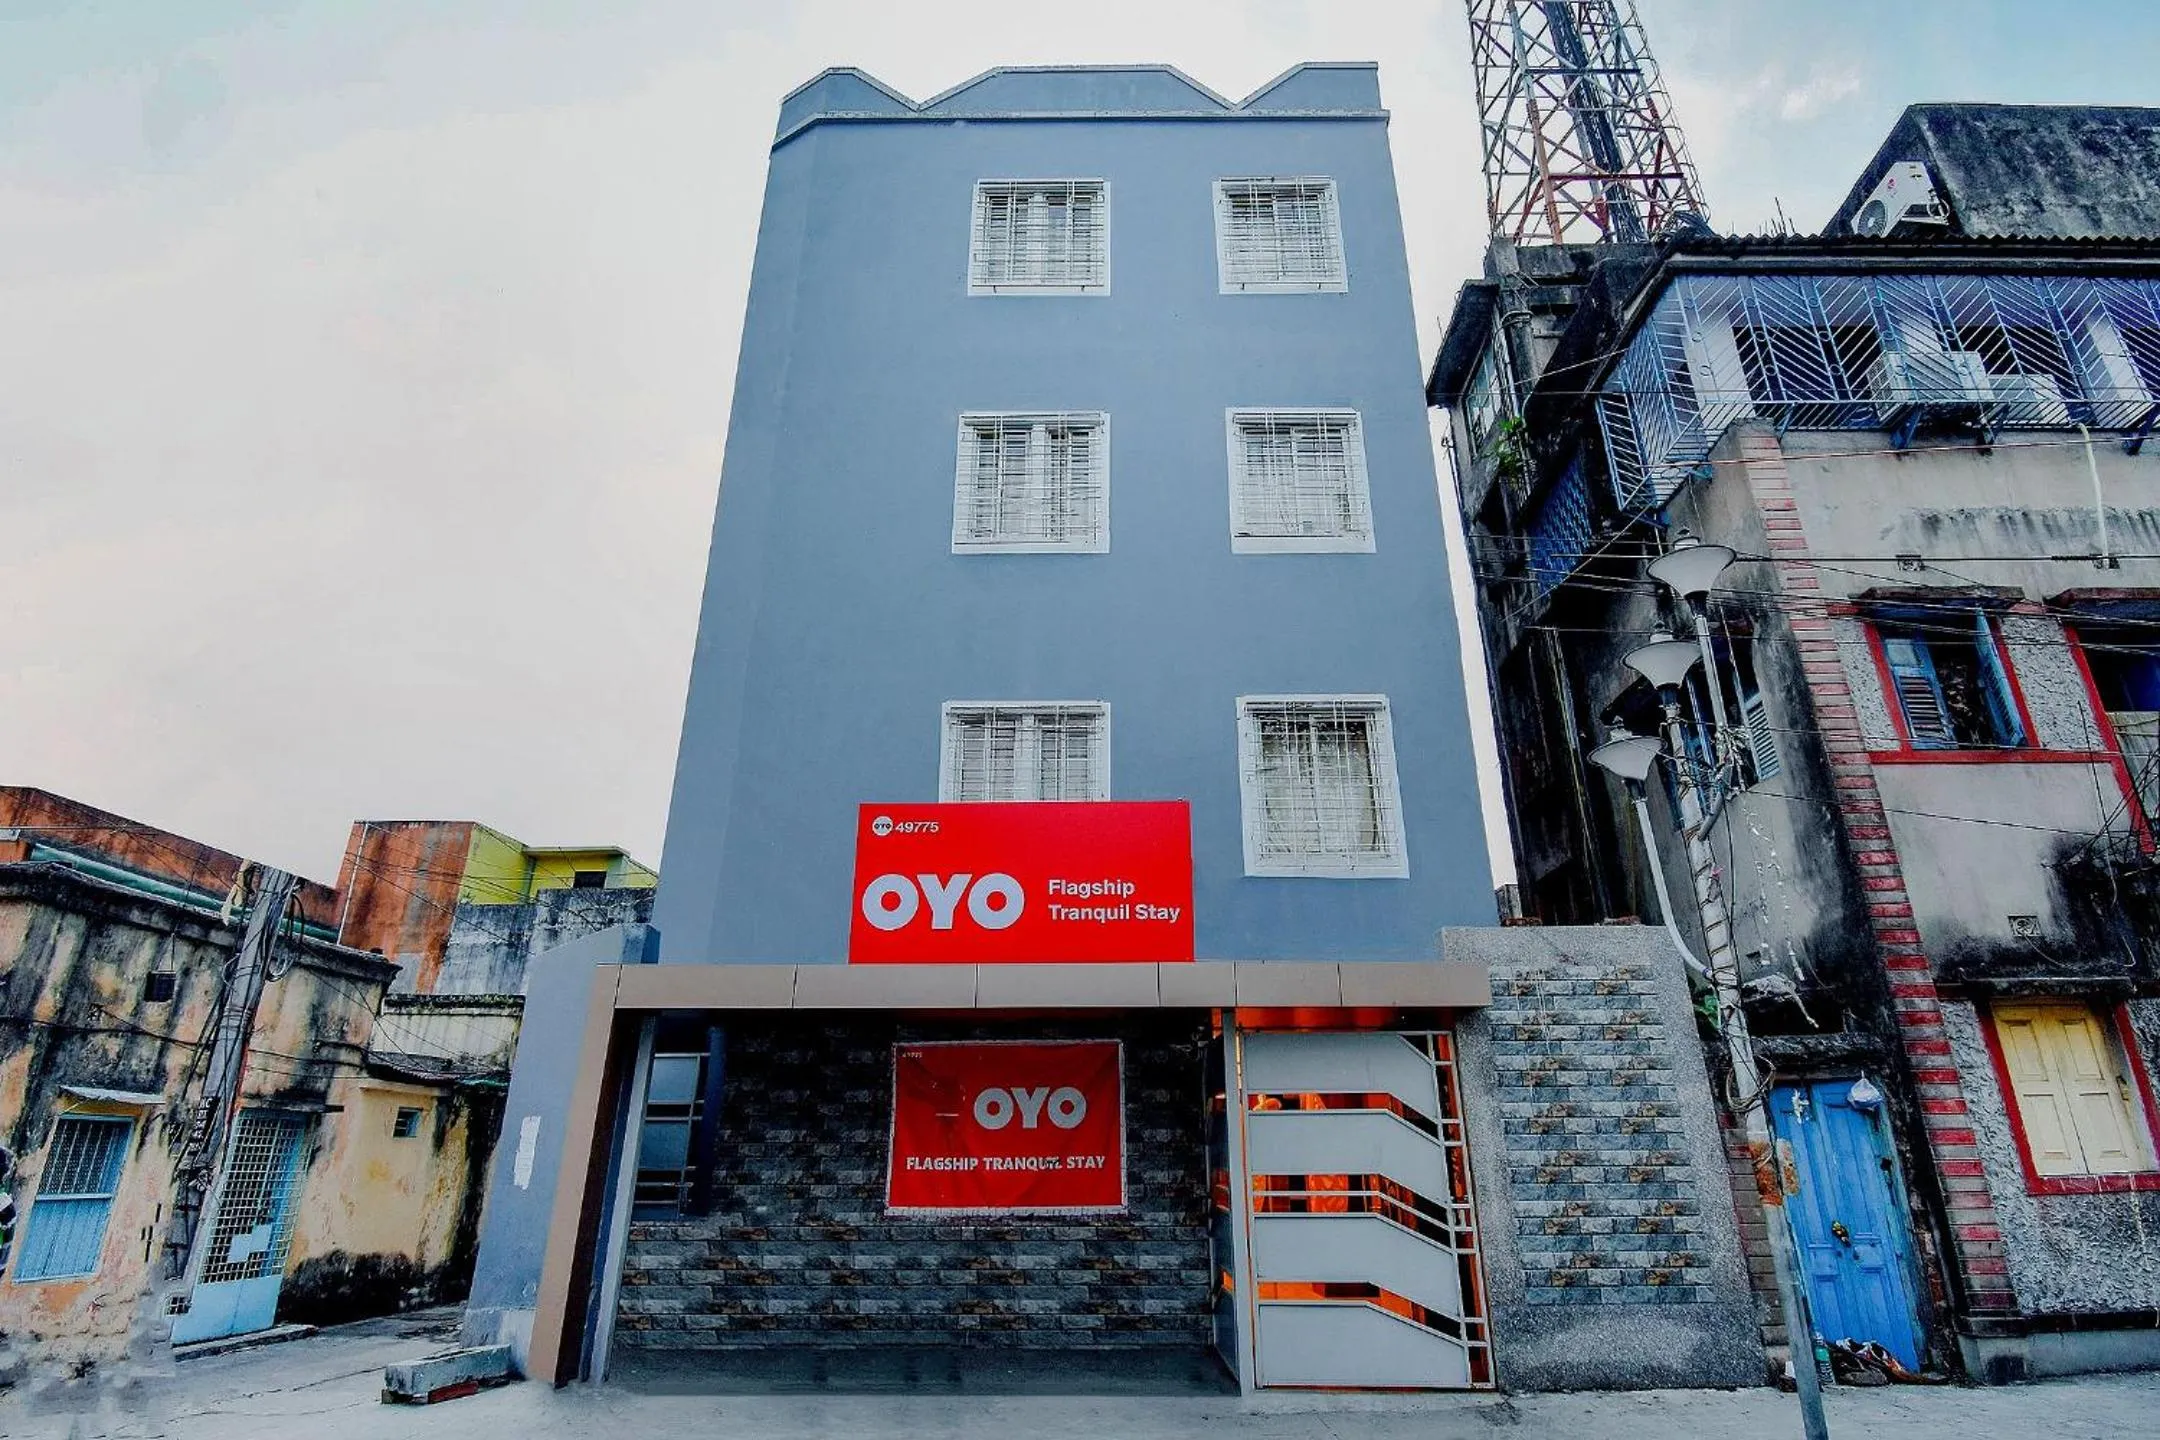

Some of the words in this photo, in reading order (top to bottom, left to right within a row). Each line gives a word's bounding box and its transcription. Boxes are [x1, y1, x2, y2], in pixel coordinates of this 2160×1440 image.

[895, 821, 940, 833] 49775
[1048, 879, 1135, 899] Flagship
[862, 873, 1025, 931] OYO
[1048, 904, 1130, 923] Tranquil
[1134, 903, 1180, 923] Stay
[974, 1087, 1087, 1129] OYO
[906, 1157, 978, 1171] FLAGSHIP
[1066, 1155, 1106, 1169] STAY
